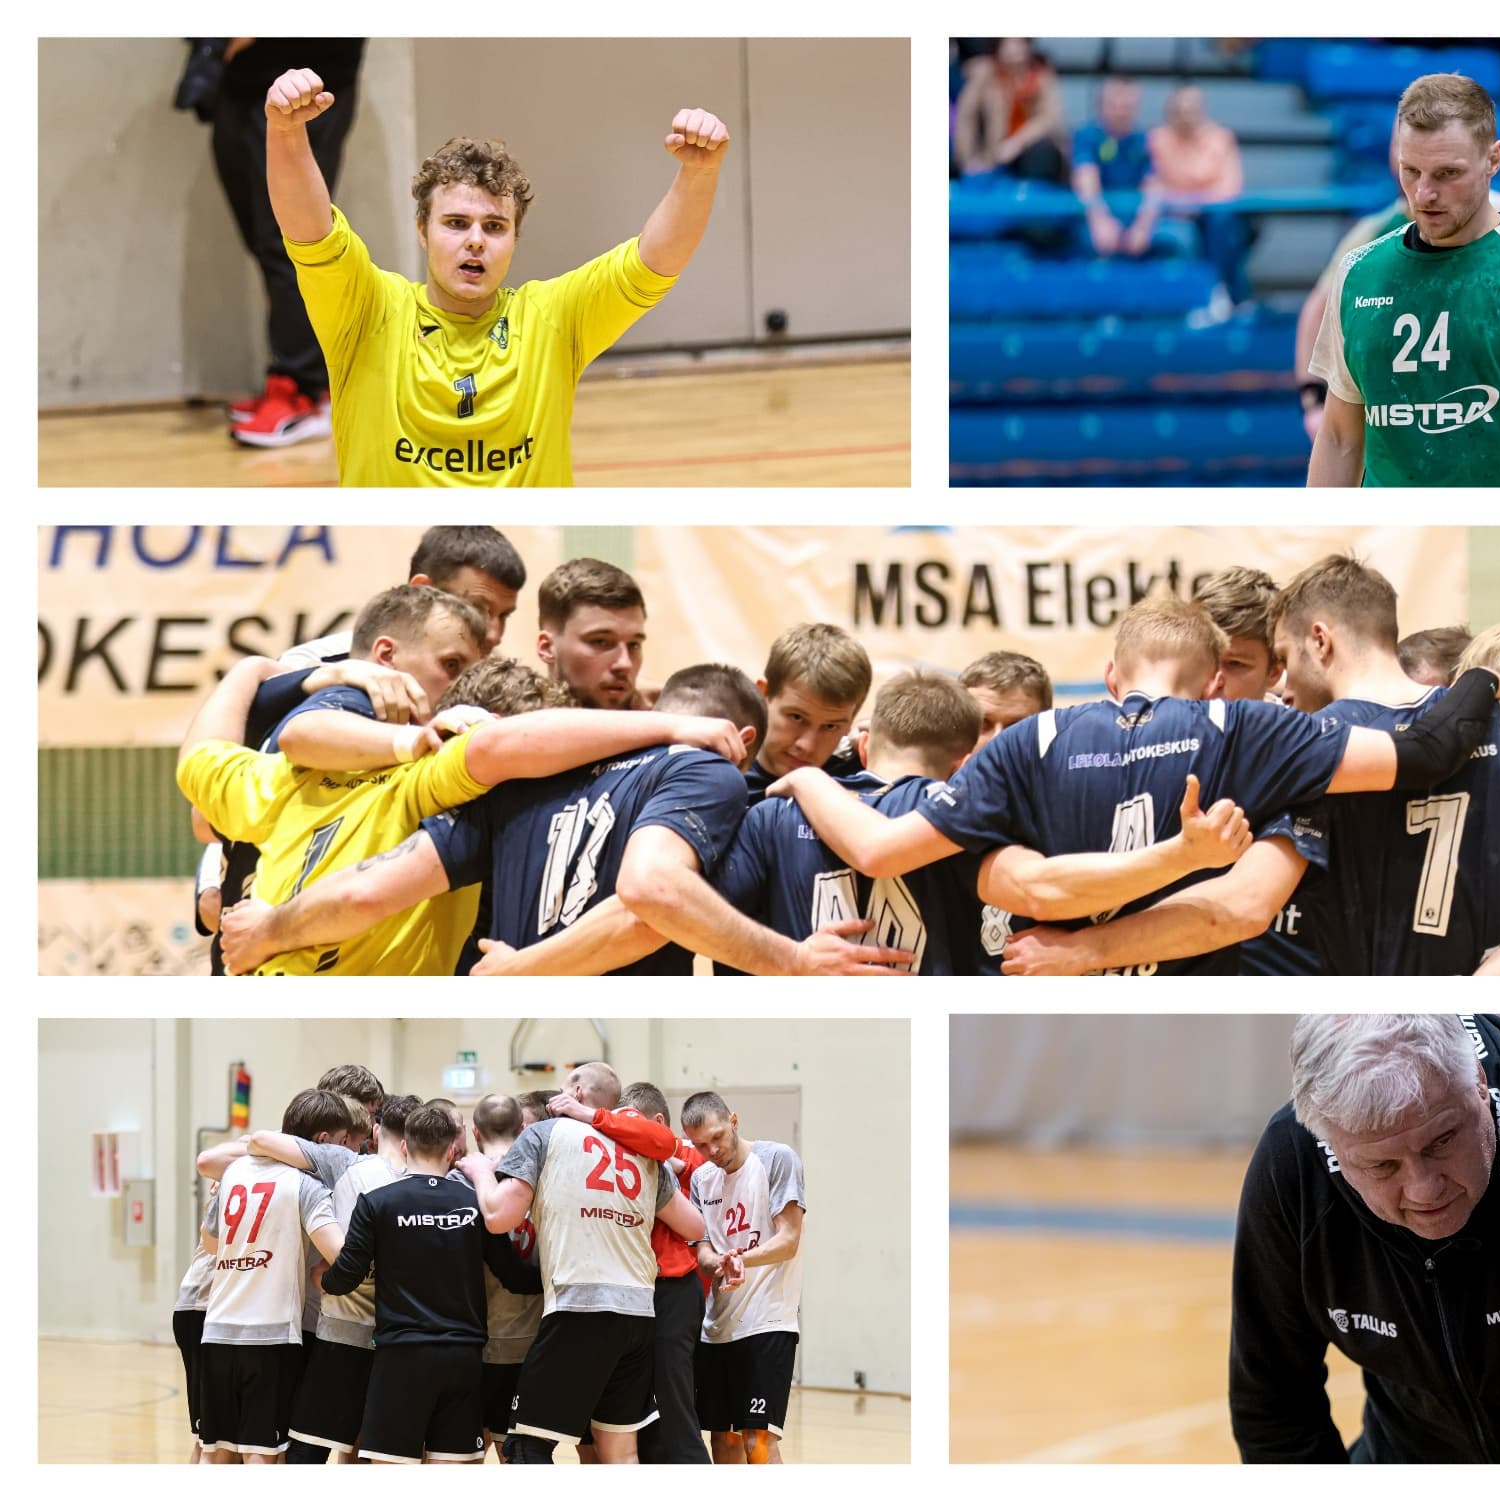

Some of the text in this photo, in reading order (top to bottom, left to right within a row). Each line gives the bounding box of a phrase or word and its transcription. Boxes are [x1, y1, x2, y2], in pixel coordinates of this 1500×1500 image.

[1354, 296, 1394, 308] Kempa
[1392, 311, 1451, 373] 24
[1364, 392, 1498, 430] MISTRA
[854, 561, 1000, 627] MSA
[1122, 738, 1200, 767] ATOKESKUS
[1406, 791, 1471, 937] 7
[583, 1136, 642, 1201] 25
[223, 1181, 277, 1245] 97
[397, 1208, 478, 1229] MISTRA
[725, 1201, 752, 1237] 22
[1351, 1313, 1398, 1338] TALLAS
[749, 1398, 767, 1414] 22
